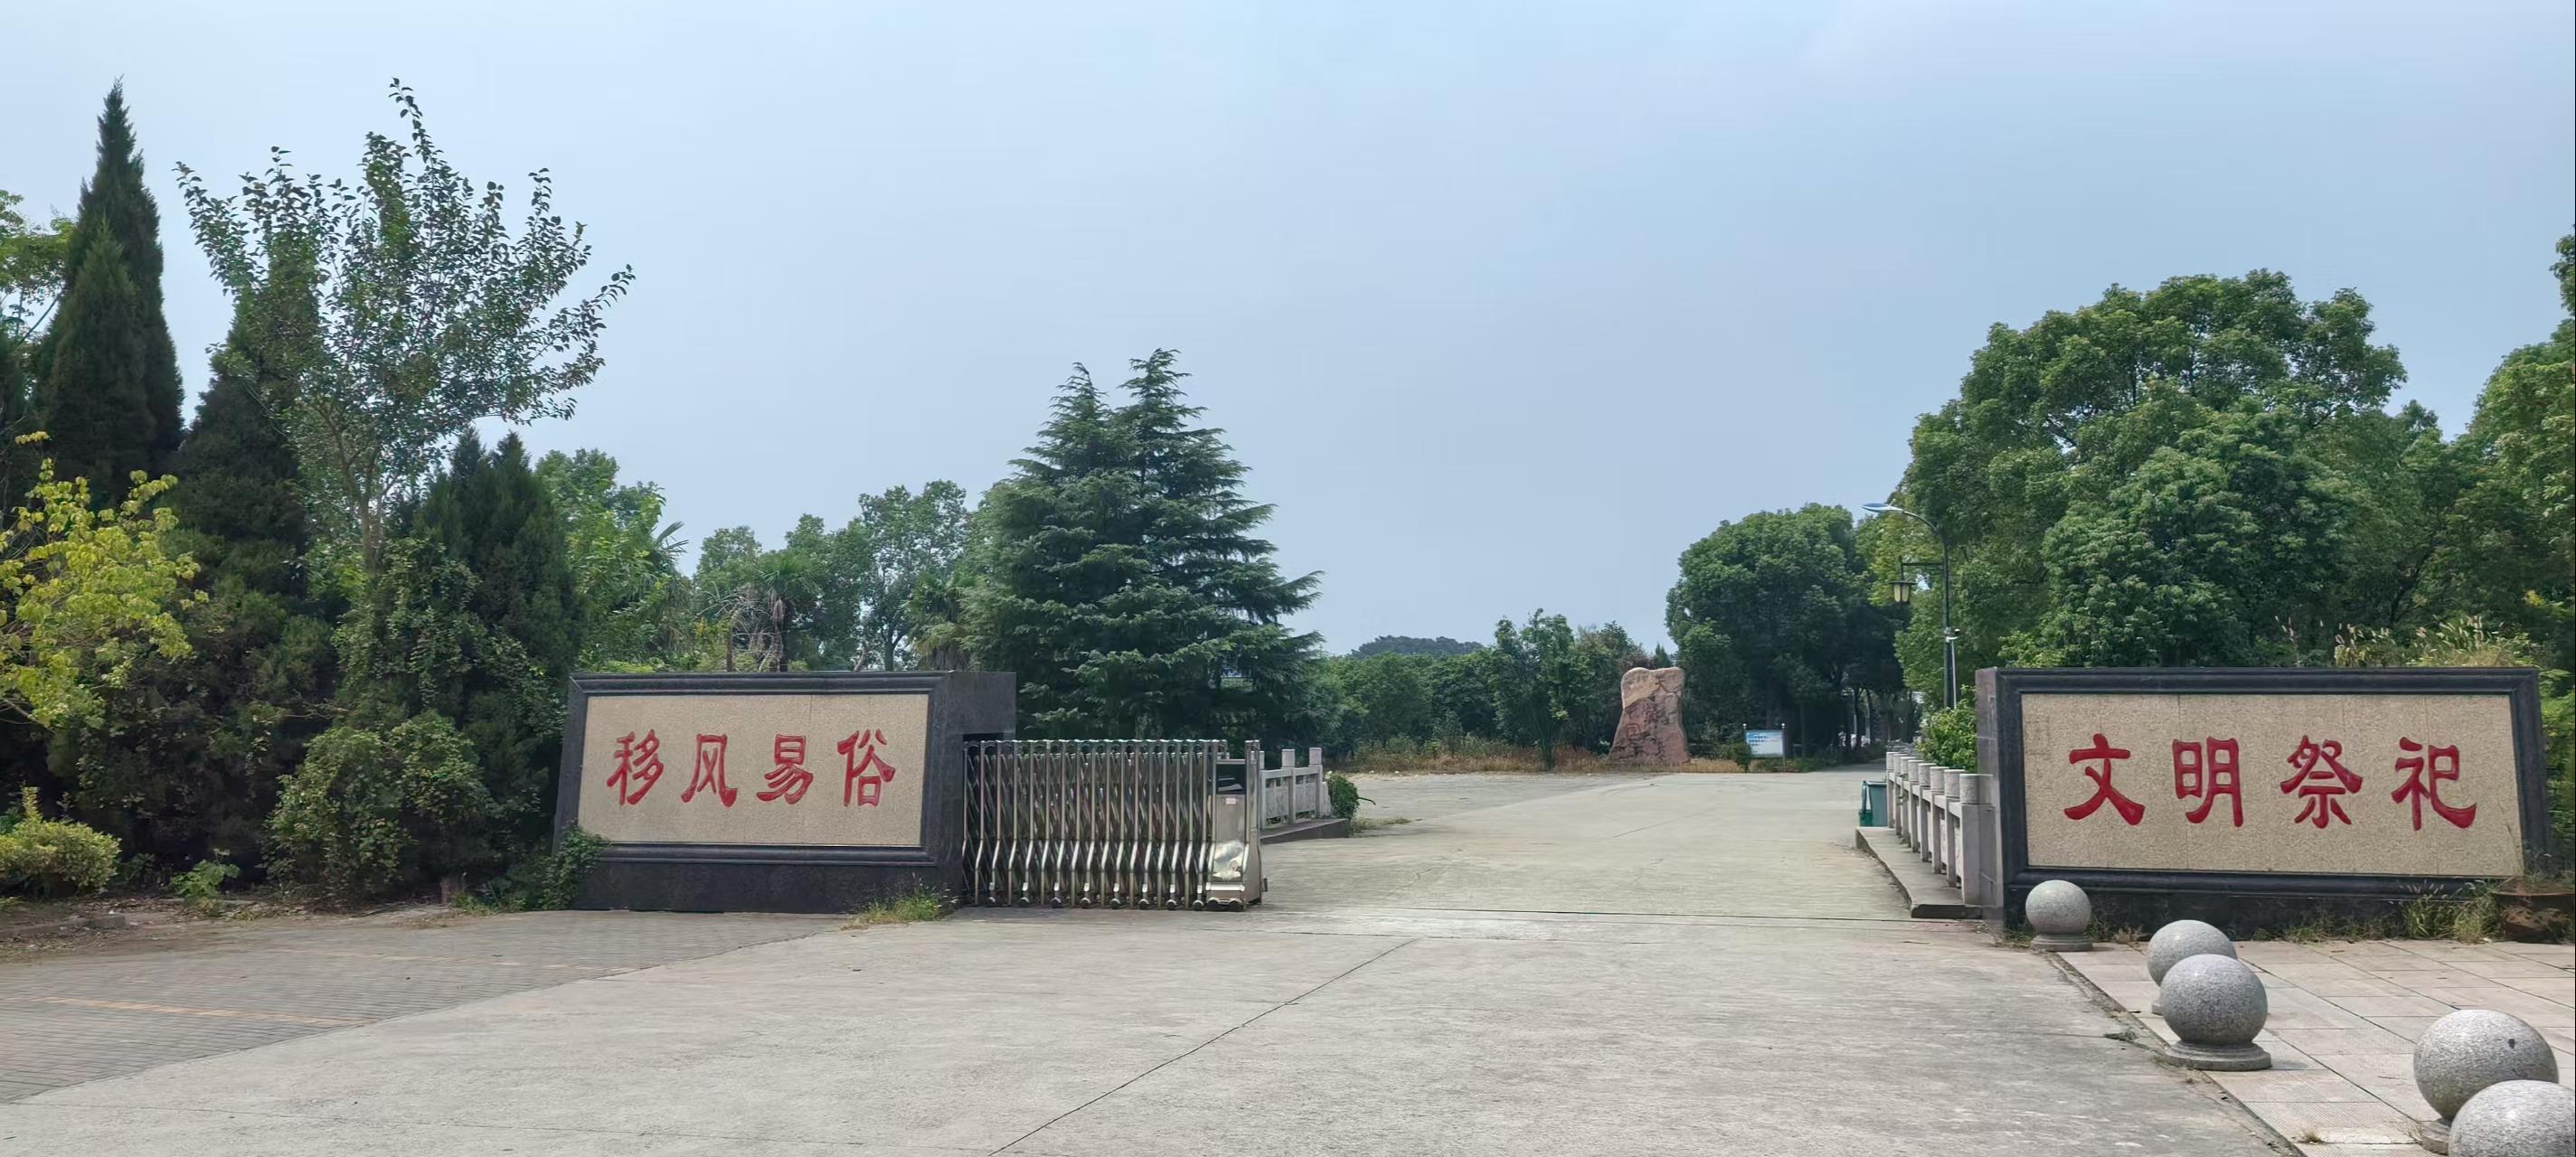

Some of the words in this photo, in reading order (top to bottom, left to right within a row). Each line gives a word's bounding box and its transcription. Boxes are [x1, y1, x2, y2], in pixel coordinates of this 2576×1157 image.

[606, 729, 896, 809] 移风易俗
[2063, 733, 2477, 832] 文明祭祀
